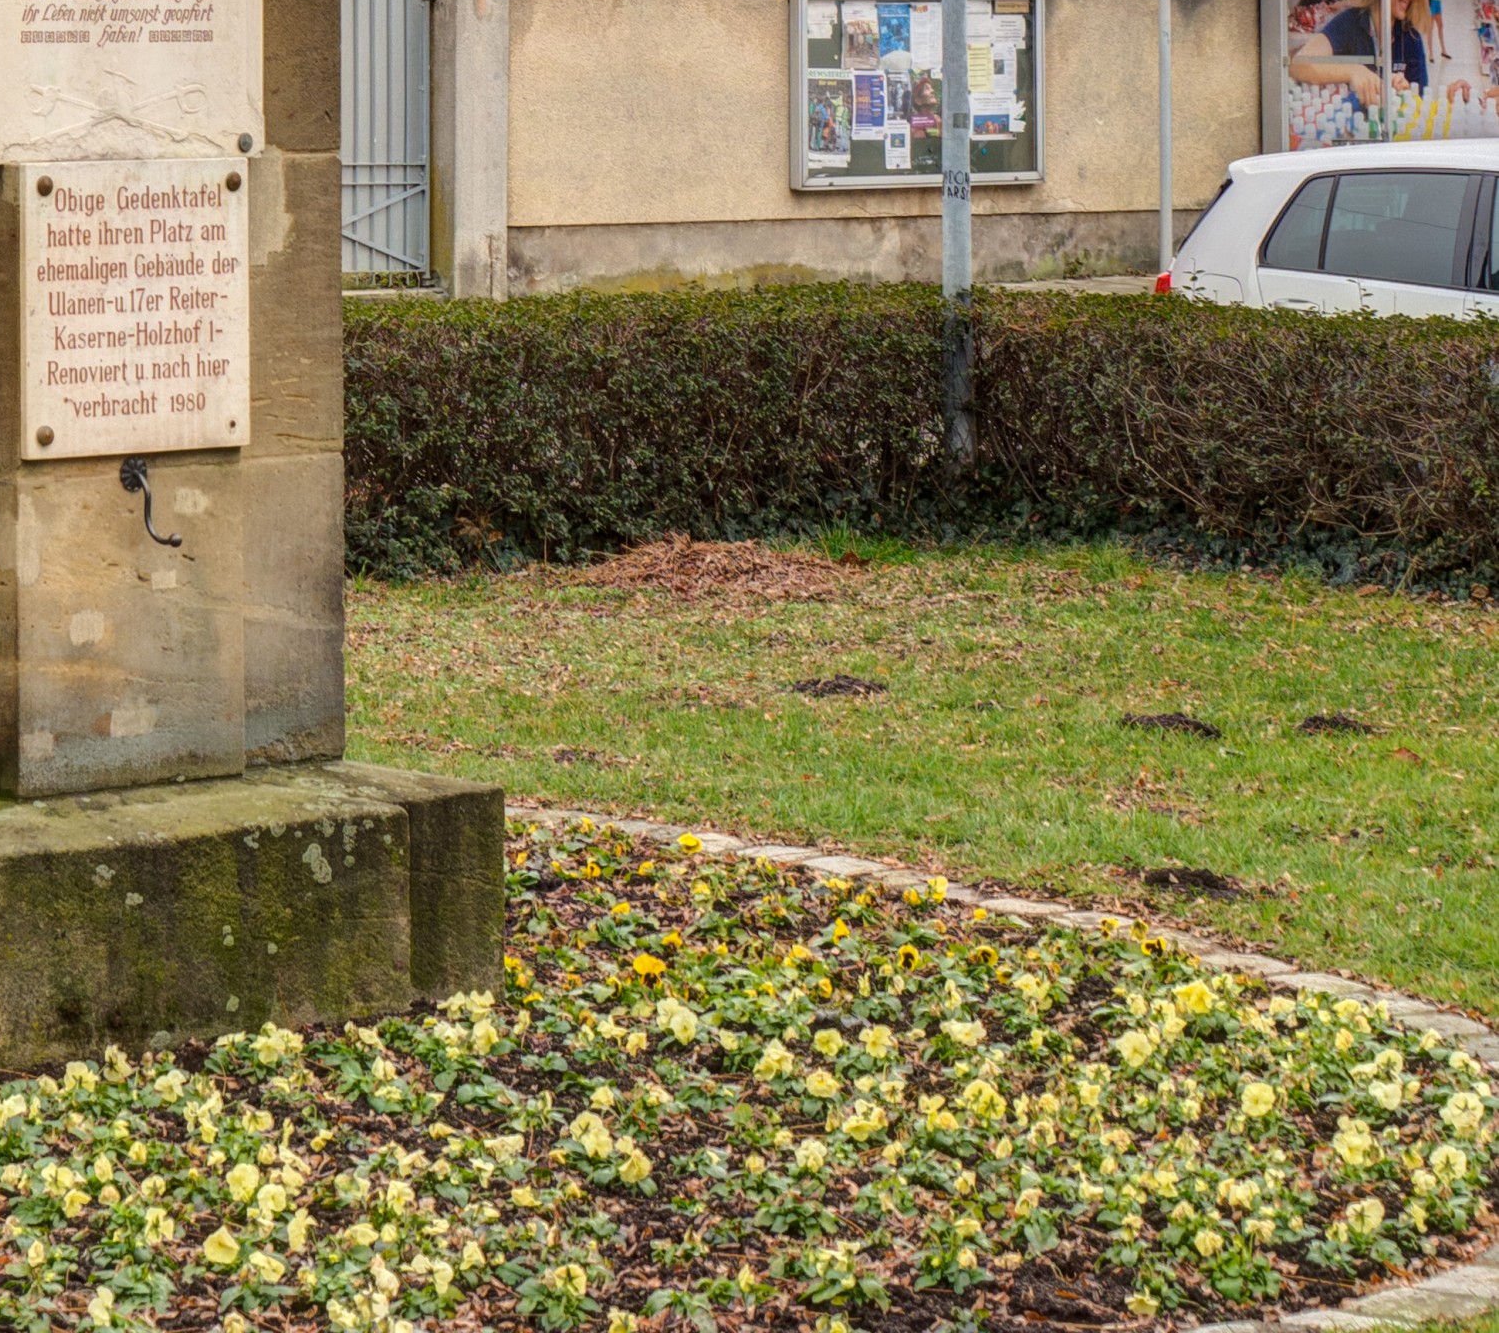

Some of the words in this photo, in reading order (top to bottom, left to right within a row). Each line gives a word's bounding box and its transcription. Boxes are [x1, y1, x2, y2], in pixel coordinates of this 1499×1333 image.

[22, 4, 40, 25] ihr
[41, 3, 75, 22] Leben
[79, 4, 107, 25] nicht
[110, 4, 160, 24] umsonst
[161, 4, 214, 25] geopfert
[96, 24, 143, 47] haben!
[54, 187, 105, 216] Obige
[116, 183, 222, 210] Gedenktafel
[47, 222, 92, 247] hatte
[98, 220, 143, 245] ihren
[150, 219, 193, 243] Platz
[200, 223, 226, 241] am
[37, 255, 127, 283] ehemaligen
[134, 252, 205, 277] Gebäude
[211, 251, 238, 275] der
[169, 284, 228, 311] Reiter-
[54, 320, 202, 350] Kaserne-Holzhof
[47, 359, 127, 386] Renoviert
[135, 362, 149, 381] u.
[152, 354, 190, 379] nach
[196, 353, 230, 377] hier
[71, 390, 158, 418] verbracht
[170, 392, 206, 413] 1980
